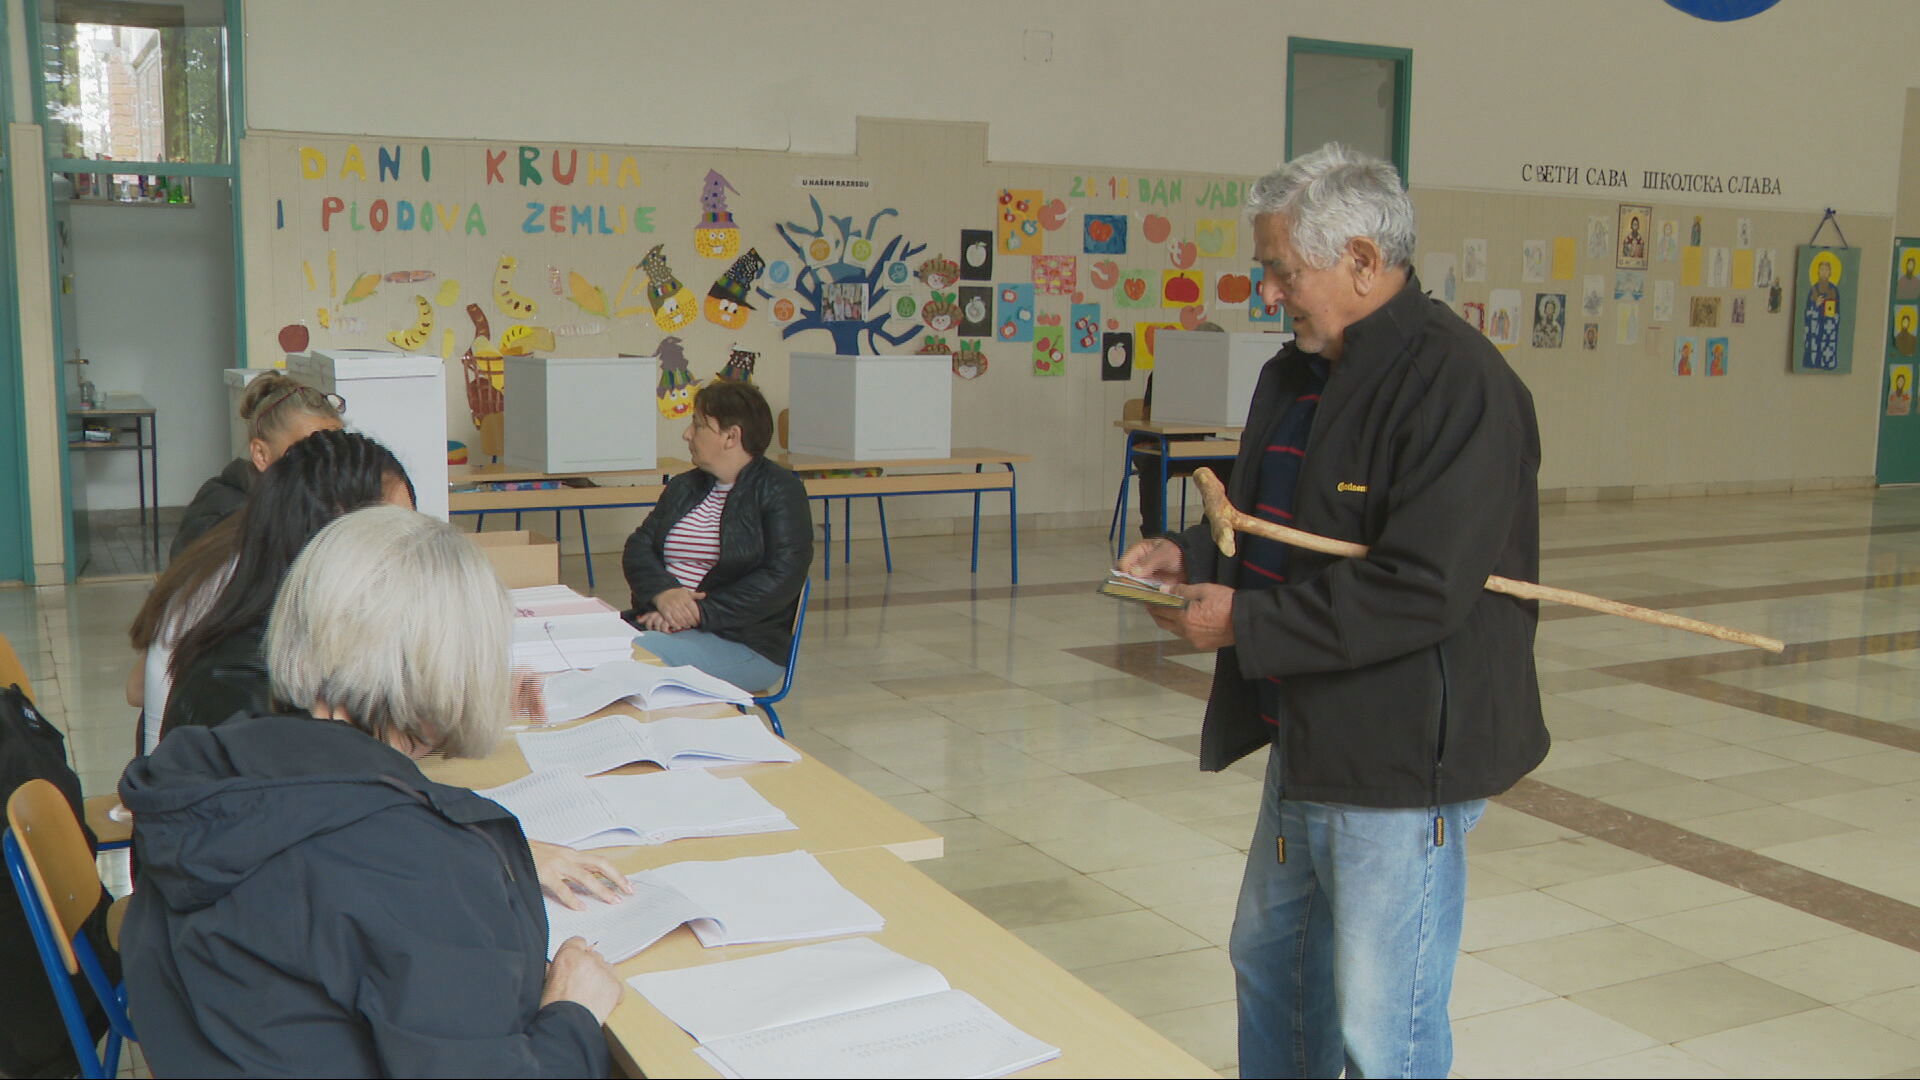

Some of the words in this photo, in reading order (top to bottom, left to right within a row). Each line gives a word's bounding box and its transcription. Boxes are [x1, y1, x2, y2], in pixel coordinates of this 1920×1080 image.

[299, 144, 431, 182] DANI
[486, 146, 641, 189] KRUHA
[1522, 163, 1579, 185] СВЕТИ
[1585, 167, 1628, 188] САВА
[1642, 170, 1723, 194] ШКОЛСКА
[1728, 175, 1782, 195] СЛАВА
[276, 199, 284, 230] I
[321, 197, 487, 237] PLODOVA
[521, 201, 657, 235] ZEMLJE
